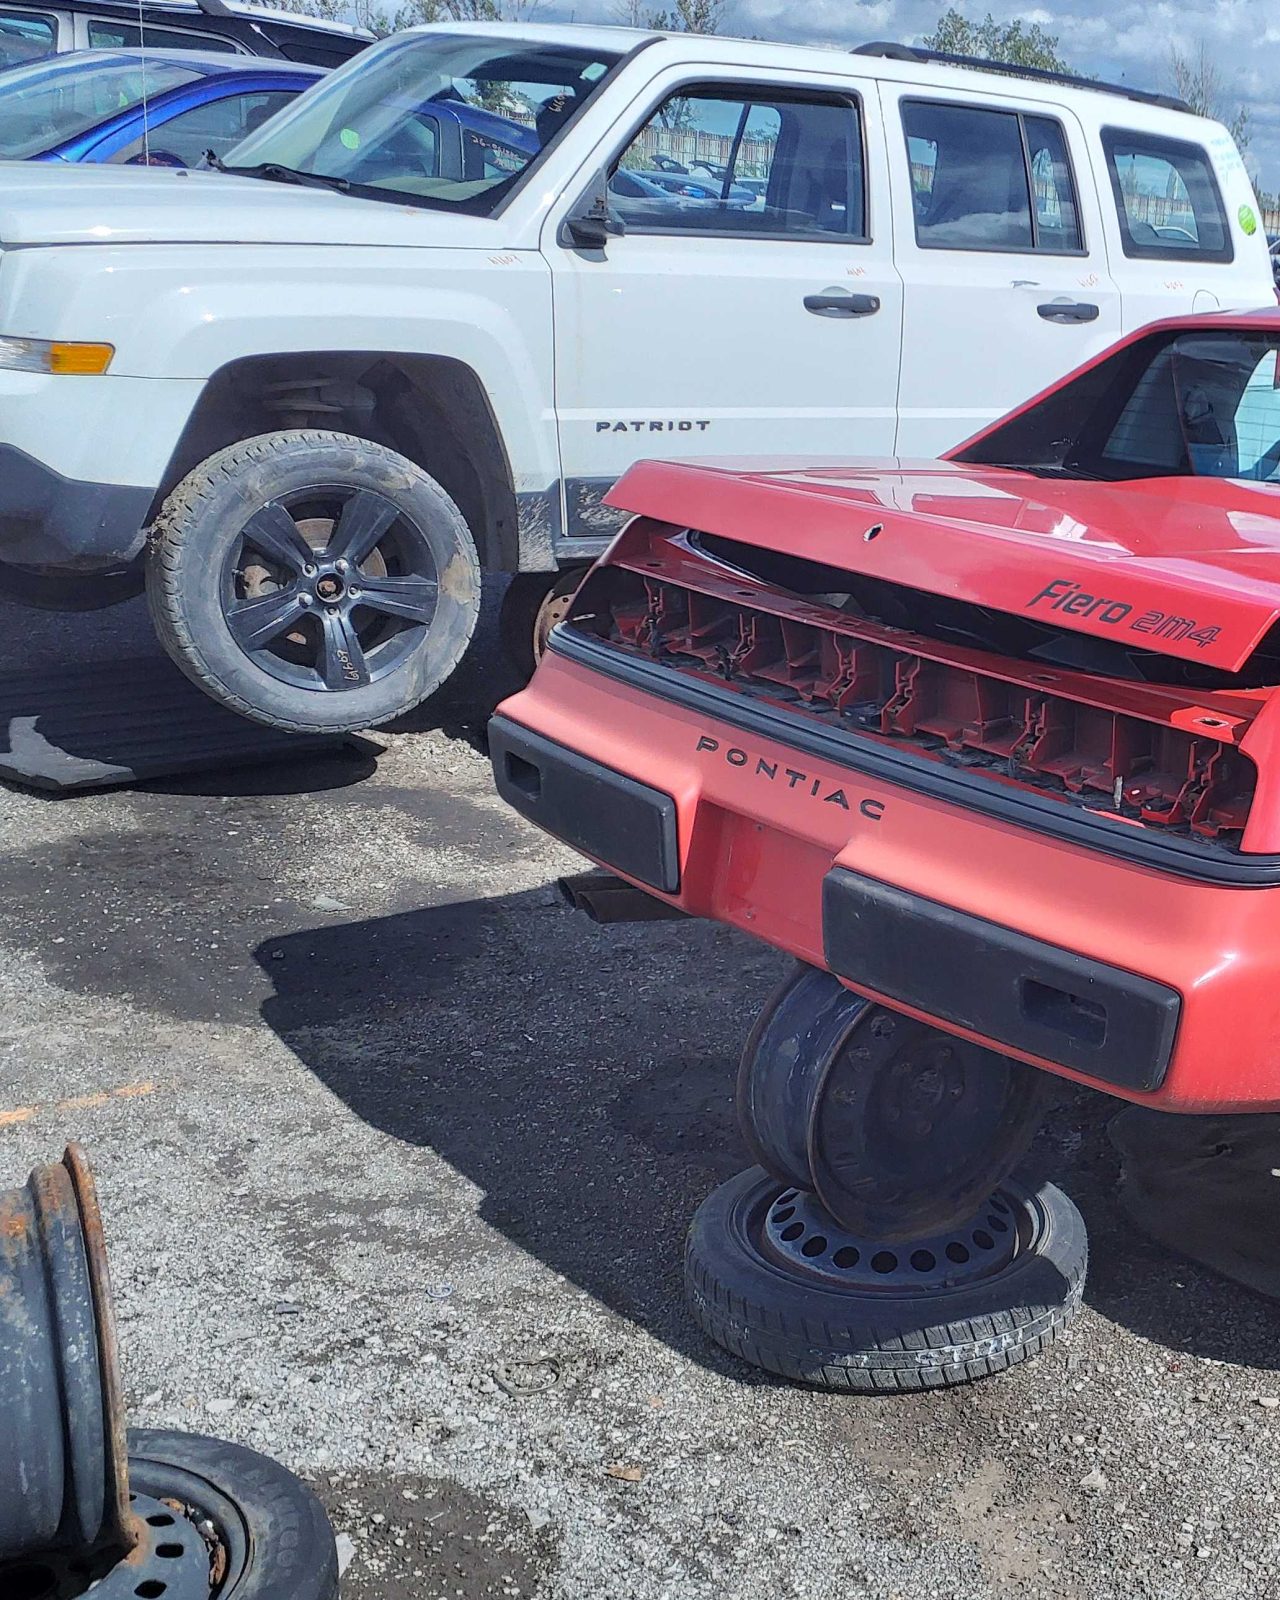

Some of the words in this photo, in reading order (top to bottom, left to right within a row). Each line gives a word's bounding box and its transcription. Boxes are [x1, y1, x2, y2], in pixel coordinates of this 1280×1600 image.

[595, 420, 711, 433] PATRIOT
[1025, 579, 1133, 624] Fiero
[695, 735, 886, 821] PONTIAC
